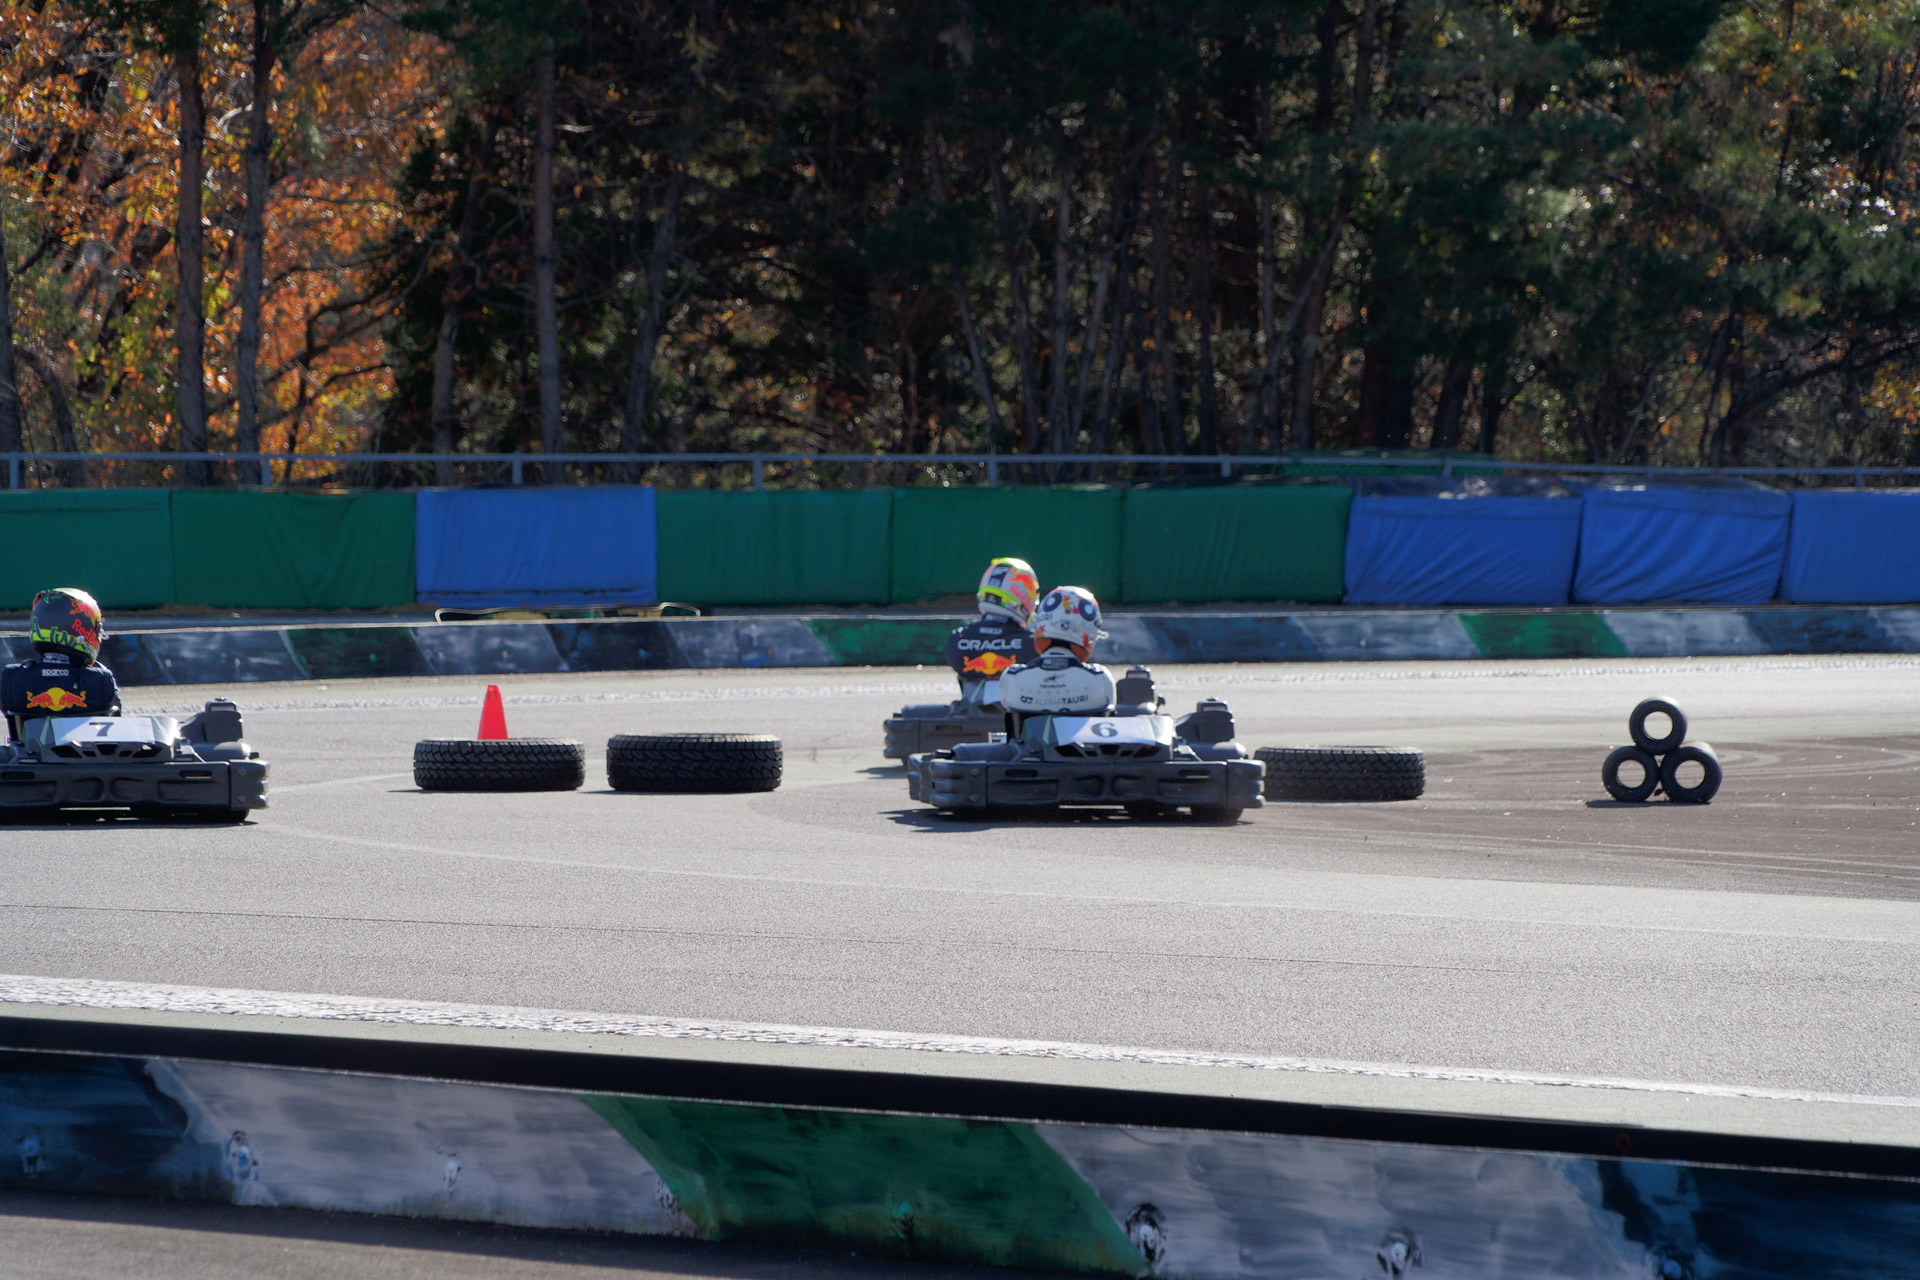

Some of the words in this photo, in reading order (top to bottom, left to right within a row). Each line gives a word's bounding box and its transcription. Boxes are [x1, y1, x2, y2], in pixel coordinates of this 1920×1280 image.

[957, 638, 1023, 651] ORACLE
[88, 721, 115, 737] 7
[1091, 721, 1119, 738] 6
